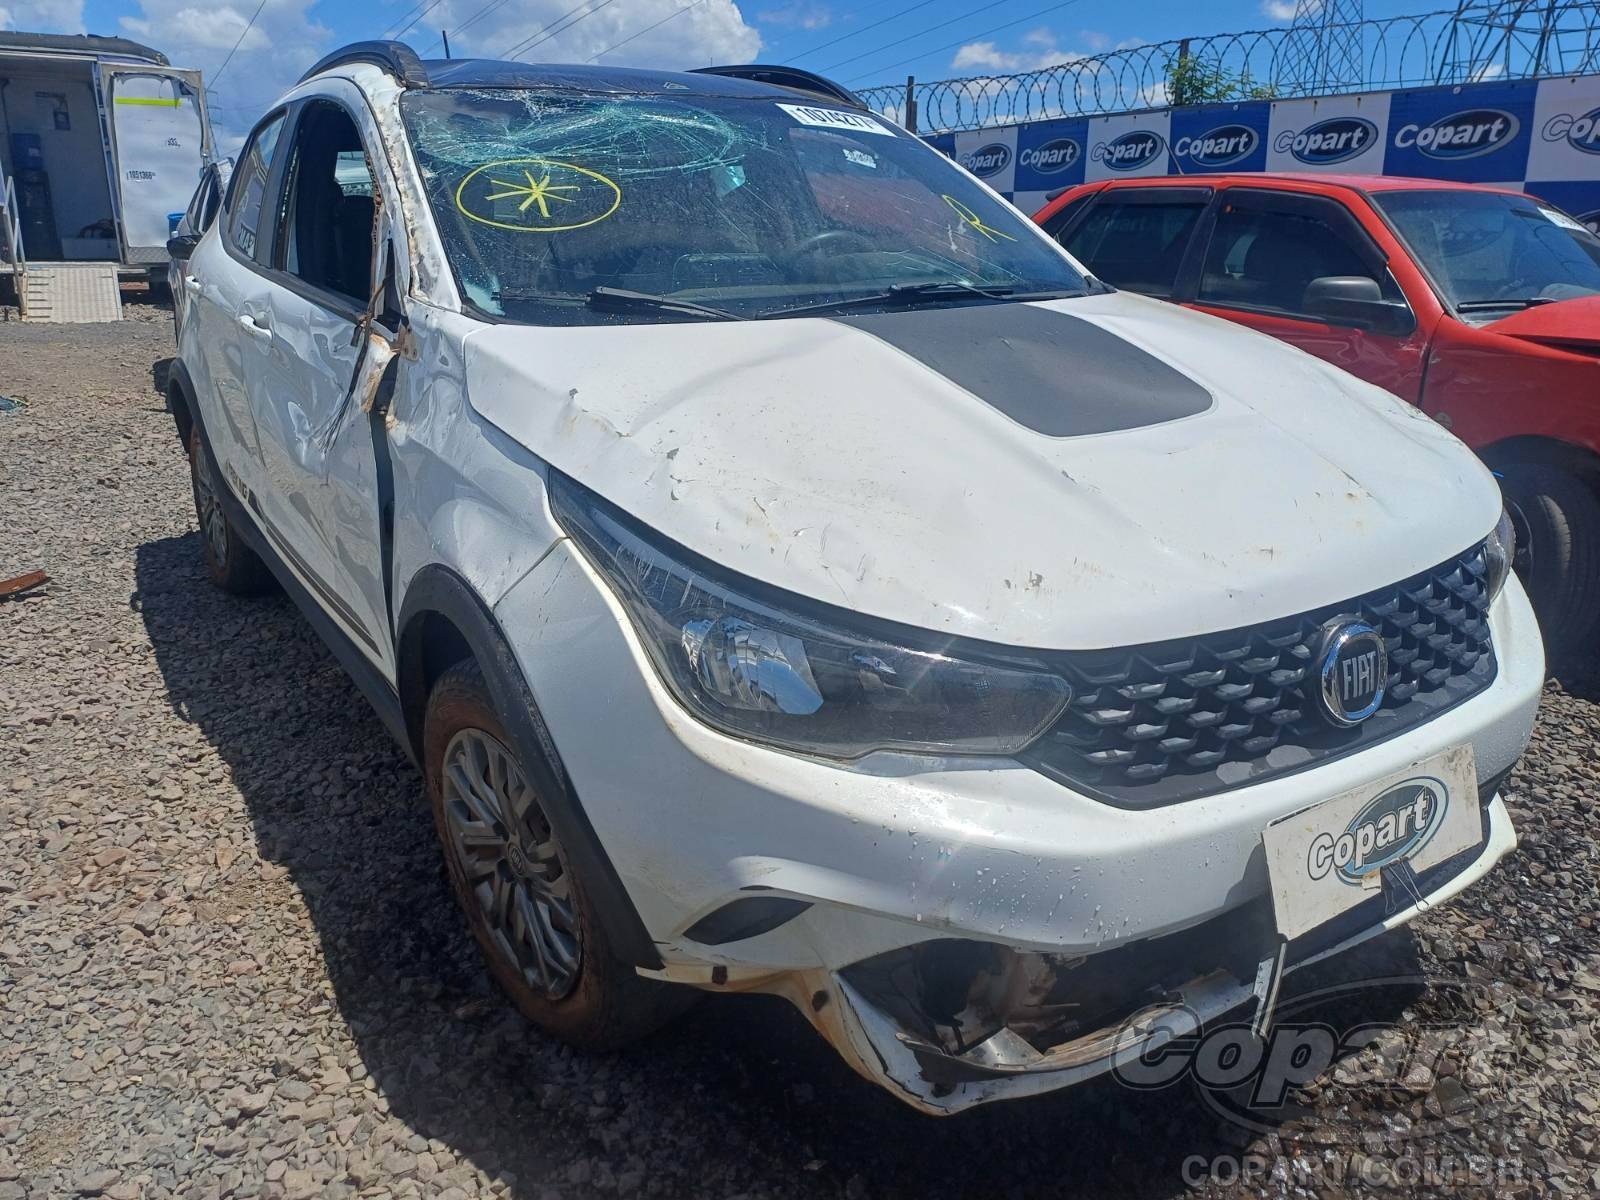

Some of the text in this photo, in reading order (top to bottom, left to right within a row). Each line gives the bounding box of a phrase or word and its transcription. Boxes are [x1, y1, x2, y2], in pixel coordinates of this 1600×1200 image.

[1175, 132, 1249, 158] Copart
[1274, 126, 1364, 155] Copart
[1394, 117, 1504, 150] Copart
[1019, 144, 1074, 166] Copart
[1091, 138, 1154, 162] Copart
[1342, 651, 1376, 700] FIAT
[1307, 786, 1430, 881] Copart
